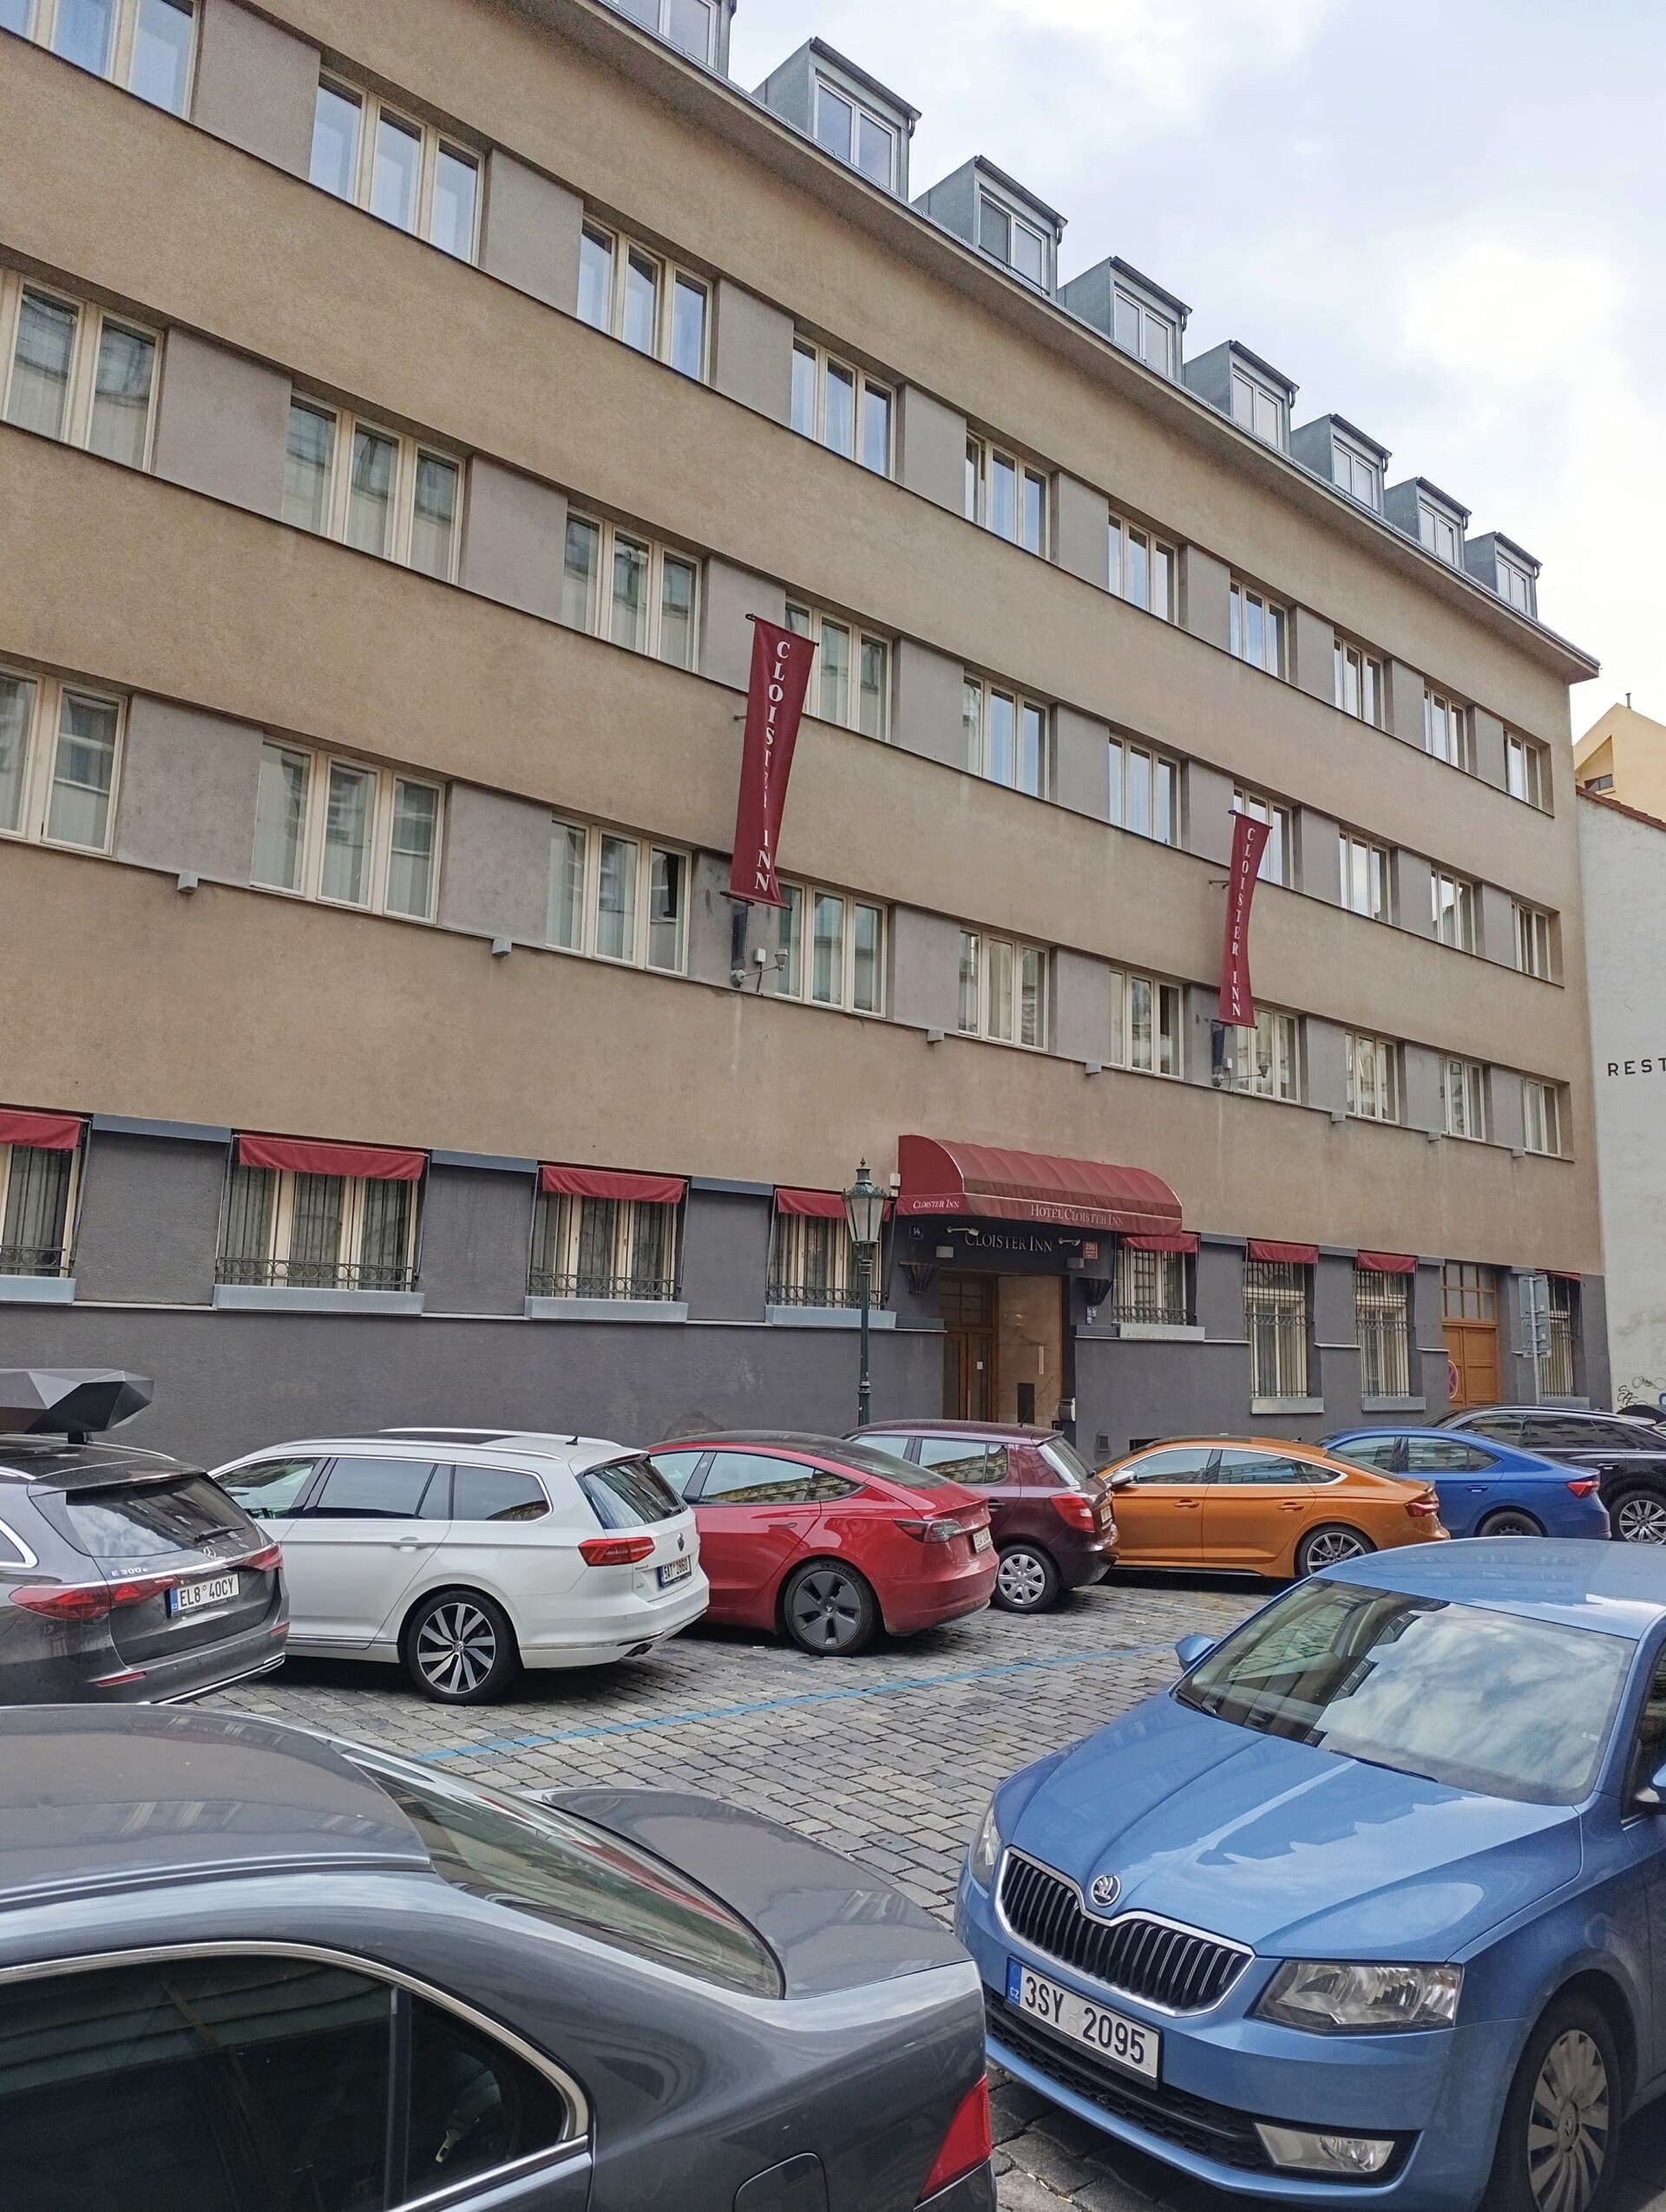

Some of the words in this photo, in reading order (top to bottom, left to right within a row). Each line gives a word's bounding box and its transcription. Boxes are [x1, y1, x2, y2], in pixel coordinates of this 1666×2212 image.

[754, 829, 771, 893] INN
[1232, 828, 1256, 956] CLOISTER
[1232, 971, 1241, 1017] INN
[1607, 1057, 1666, 1077] REST
[946, 1199, 960, 1208] INN
[1031, 1204, 1063, 1220] HOTEL
[1064, 1207, 1106, 1225] CLOISTER
[1108, 1214, 1125, 1227] INN
[965, 1234, 1026, 1250] CLOISTER
[1030, 1235, 1052, 1252] INN
[180, 1587, 200, 1607] EL8
[1010, 1986, 1020, 1999] CZ
[1026, 1976, 1065, 2024] 3SY
[1082, 2007, 1145, 2064] 2095
